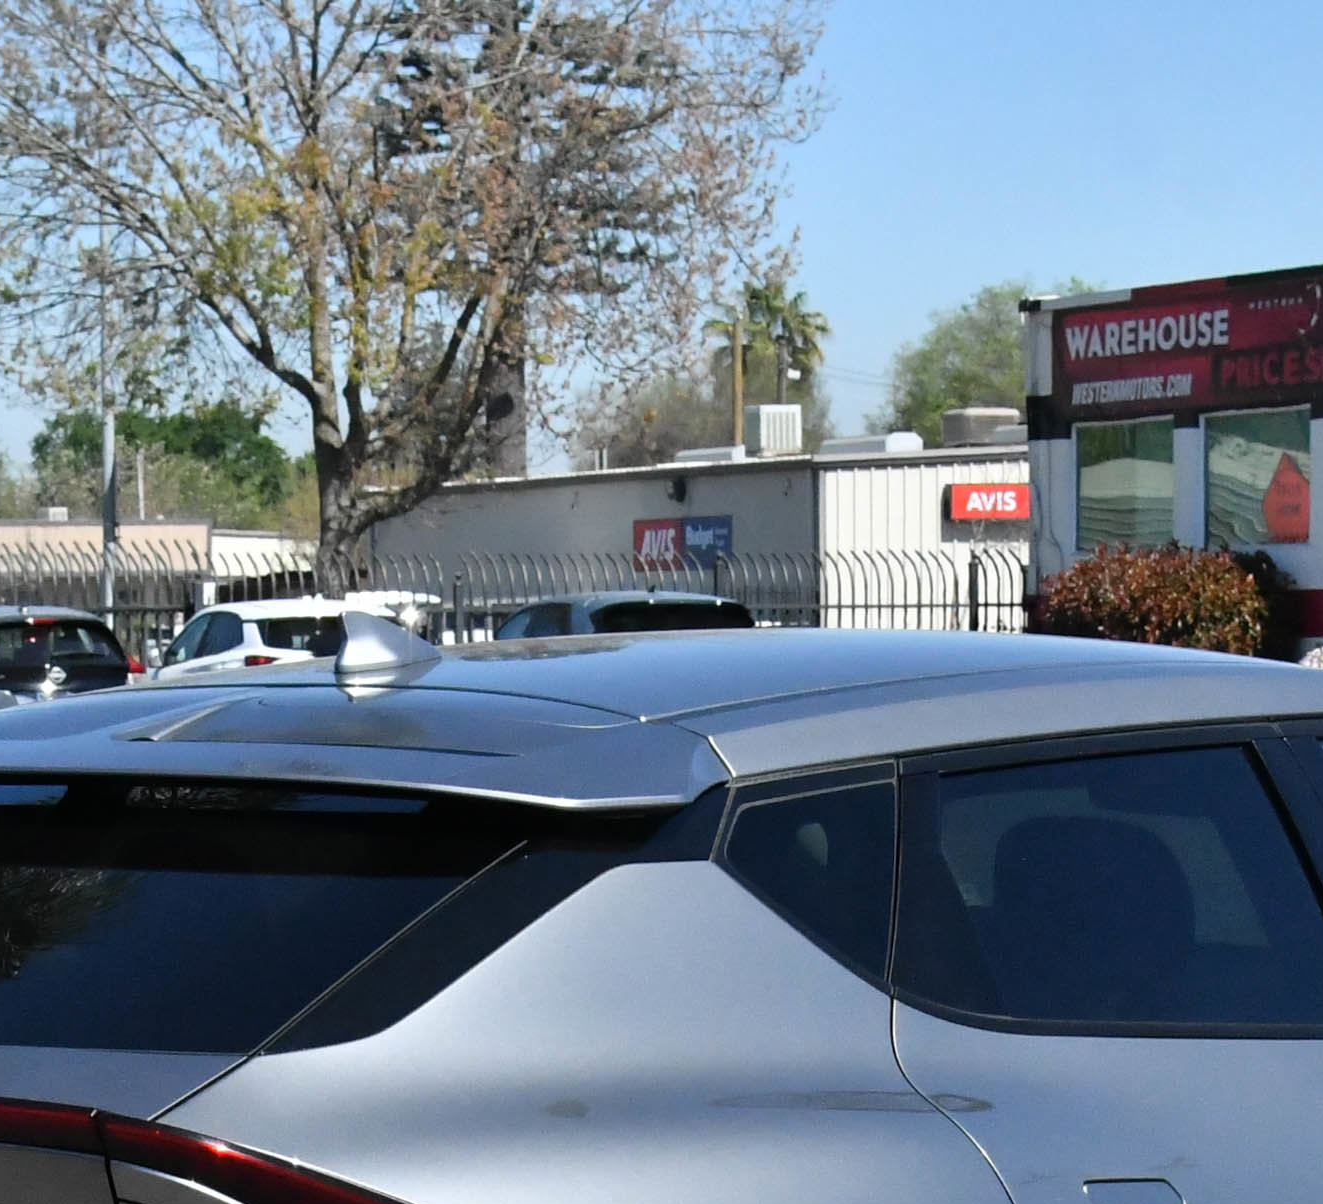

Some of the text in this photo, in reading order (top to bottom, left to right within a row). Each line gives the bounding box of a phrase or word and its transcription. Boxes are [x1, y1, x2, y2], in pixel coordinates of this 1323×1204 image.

[1065, 309, 1230, 361] WAREHOUSE
[1071, 373, 1192, 405] WESTERNMOTORS.COM
[966, 490, 1017, 512] AVIS
[641, 528, 676, 561] AVIS
